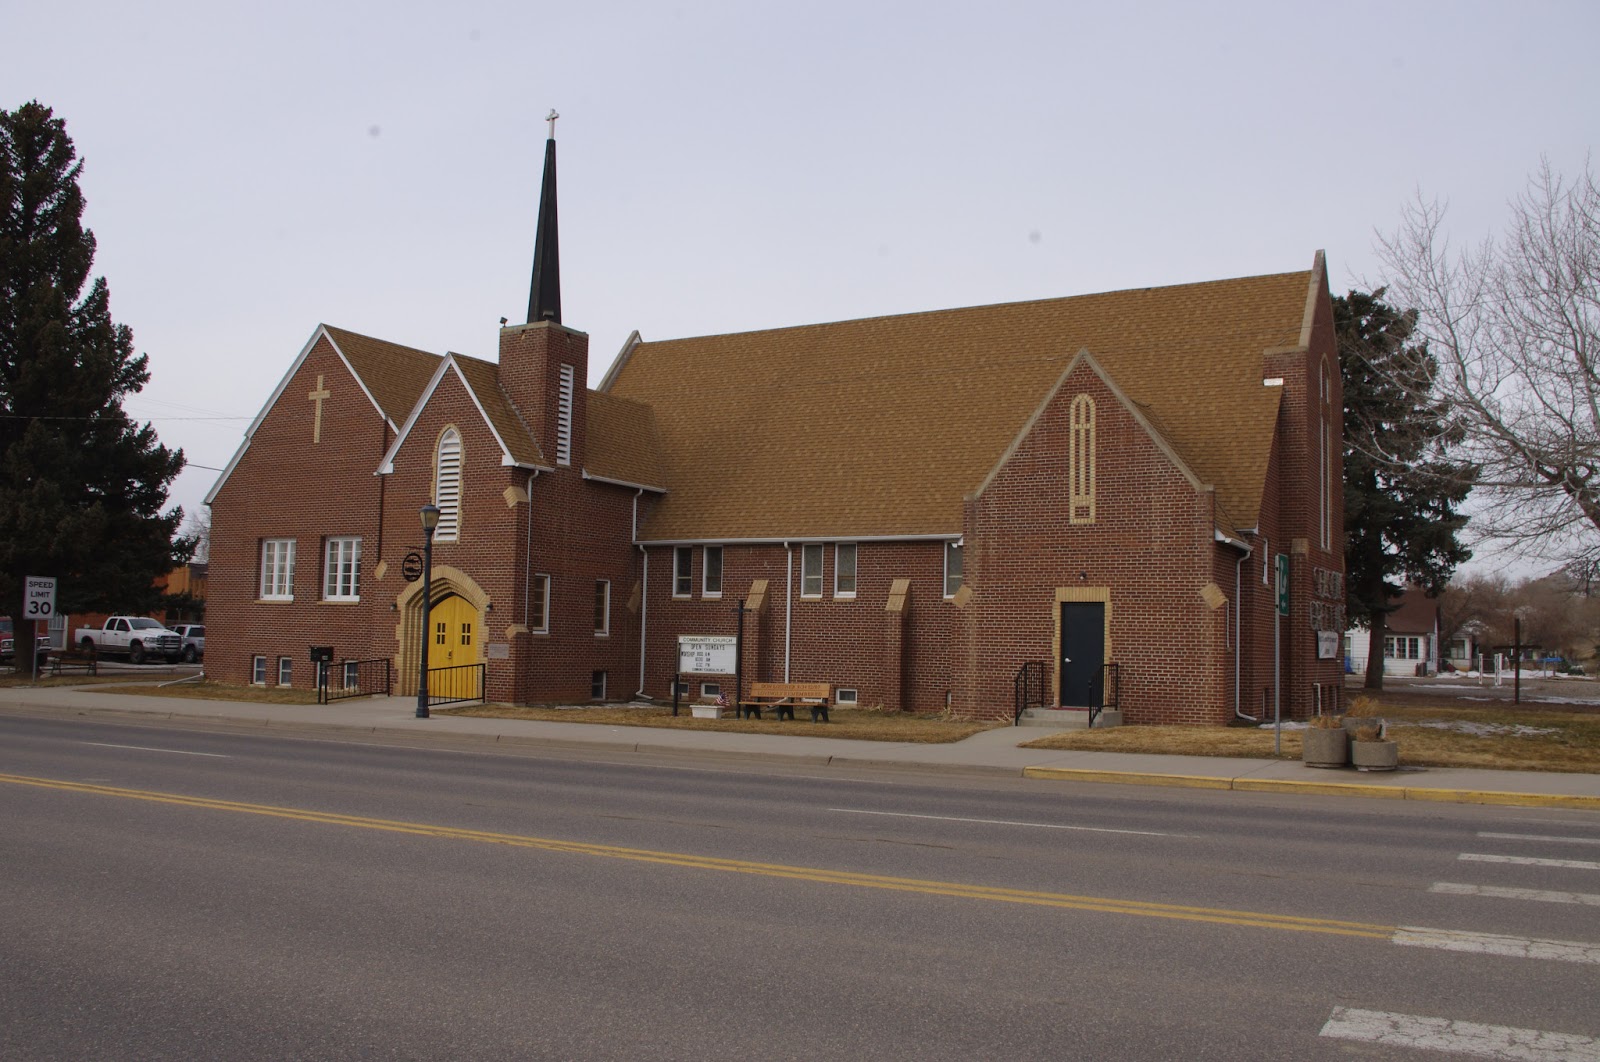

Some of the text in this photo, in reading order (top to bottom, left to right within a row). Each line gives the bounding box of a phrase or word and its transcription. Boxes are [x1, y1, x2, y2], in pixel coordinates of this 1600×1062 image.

[28, 581, 54, 589] SPEED
[30, 590, 51, 598] LIMIT
[28, 600, 52, 615] 30
